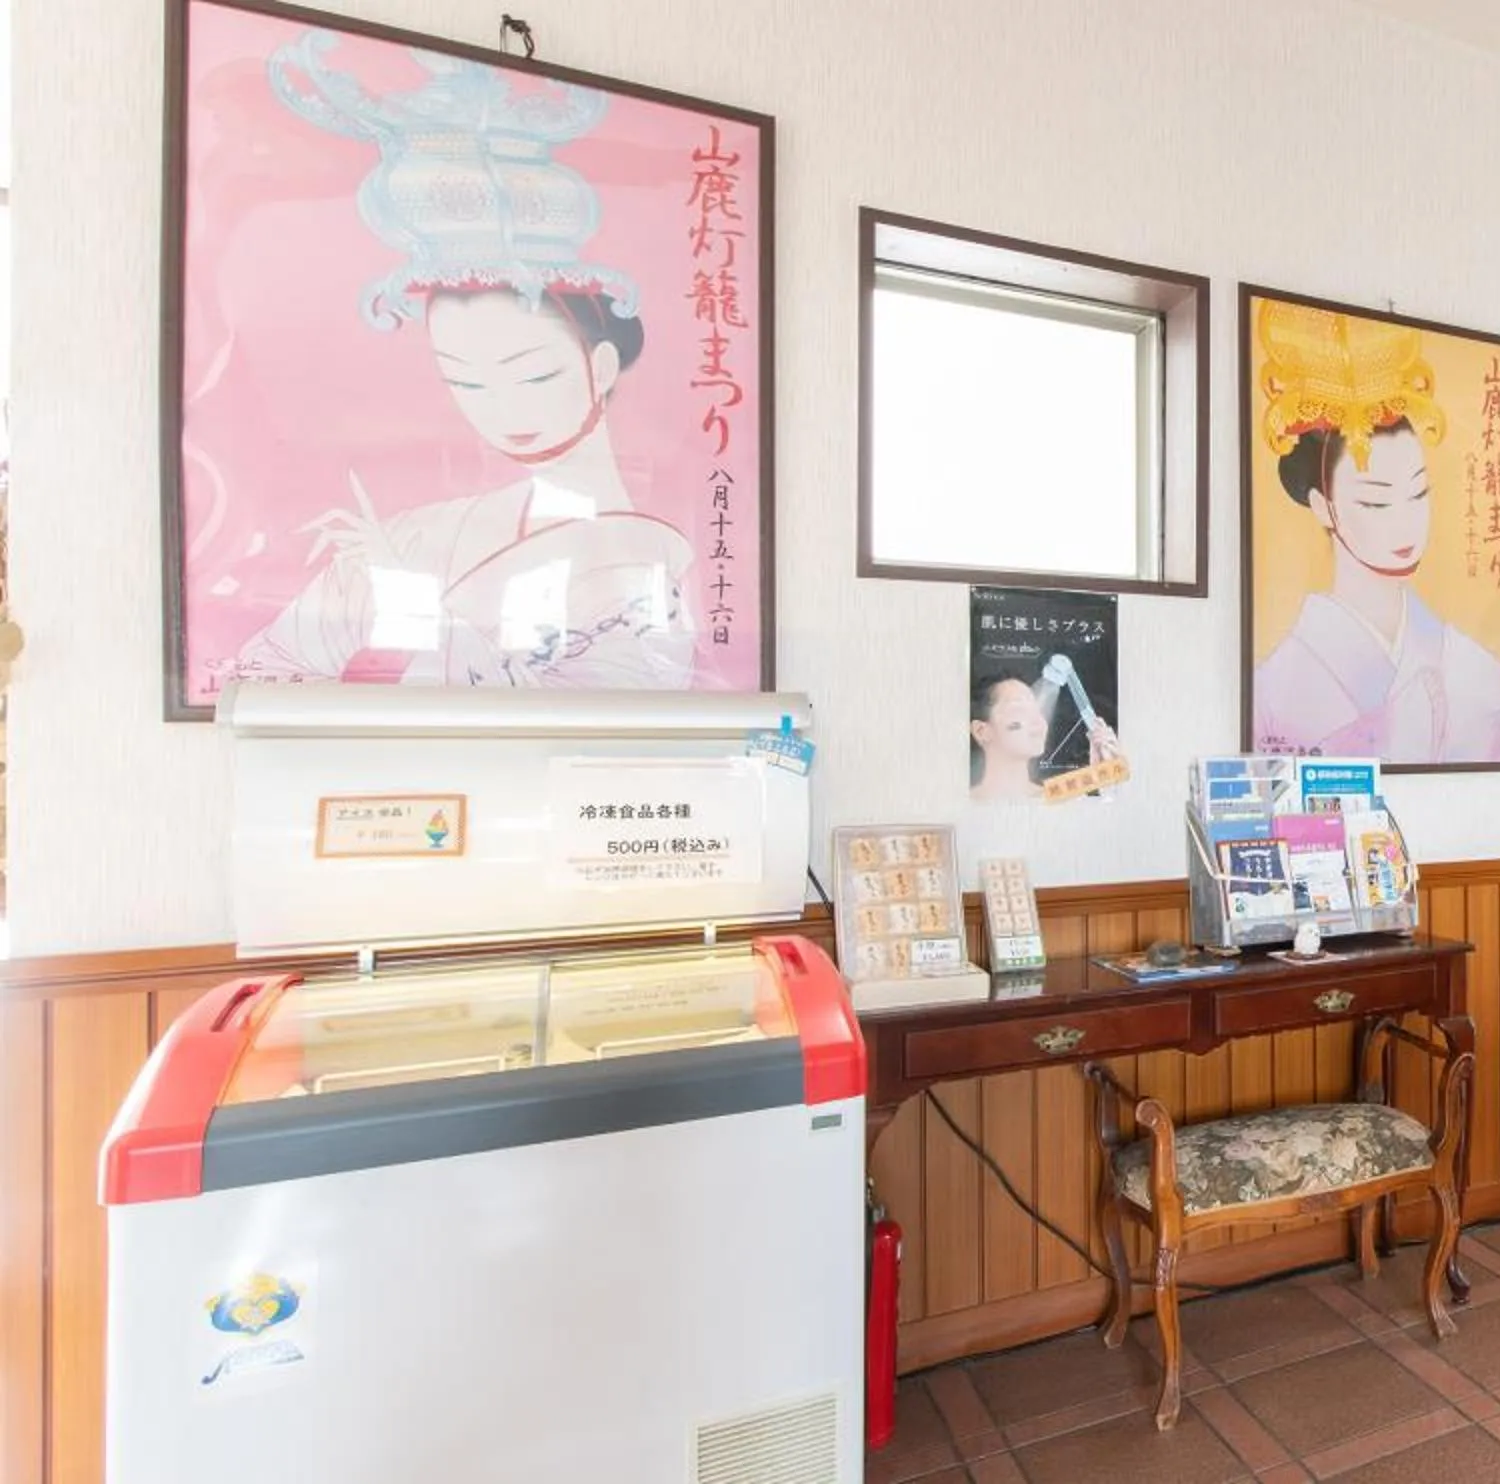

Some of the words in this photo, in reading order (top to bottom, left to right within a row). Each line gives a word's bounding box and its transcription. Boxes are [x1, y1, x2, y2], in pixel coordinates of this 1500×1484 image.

[686, 125, 748, 457] 山鹿灯籠まつり
[708, 468, 735, 645] 八月十五・十六日
[981, 615, 1105, 634] 肌に優しさプラス
[579, 803, 692, 819] 冷凍食品各種
